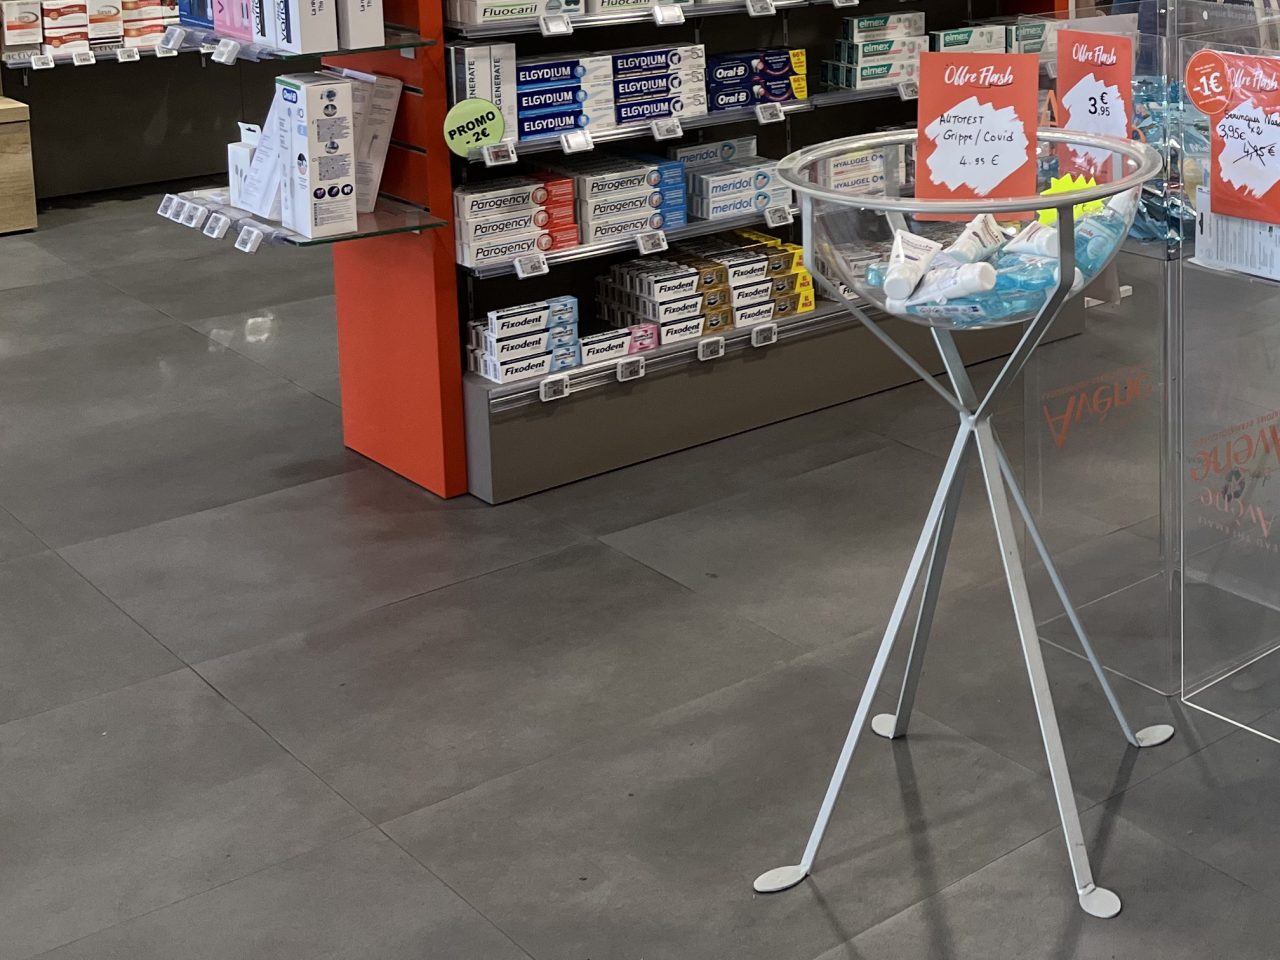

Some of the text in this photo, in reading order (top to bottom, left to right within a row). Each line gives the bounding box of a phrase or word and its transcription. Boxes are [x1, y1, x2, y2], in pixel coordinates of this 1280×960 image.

[863, 42, 889, 53] elmex
[617, 54, 666, 69] ELGYDIUM
[519, 66, 571, 80] ELGYDIUM
[944, 65, 1014, 86] Offre Flash
[619, 78, 667, 93] ELGYDIUM
[522, 92, 573, 107] ELGYDIUM
[621, 100, 669, 118] ELGYDIUM
[448, 110, 496, 140] PROMO
[523, 115, 575, 132] ELGYDIUM
[939, 115, 984, 125] AUTOTEST
[943, 130, 973, 145] Grippe
[983, 130, 1014, 142] Covid
[679, 151, 718, 163] meridol
[591, 175, 647, 191] Parogencyl
[711, 179, 753, 194] meridol
[470, 192, 531, 210] Parogencyl
[593, 197, 647, 214] Parogencyl
[711, 199, 753, 214] meridol
[474, 216, 532, 234] Parogencyl
[594, 218, 649, 236] Parogencyl
[476, 240, 535, 257] Parogencyl
[732, 265, 766, 277] Fixodent
[659, 280, 694, 293] Fixodent
[737, 287, 770, 300] Fixodent
[664, 302, 699, 315] Fixodent
[500, 315, 542, 331] Fixodent
[665, 325, 700, 337] Fixodent
[500, 337, 542, 352] Fixodent
[587, 341, 626, 357] Fixodent
[504, 360, 545, 375] Fixodent
